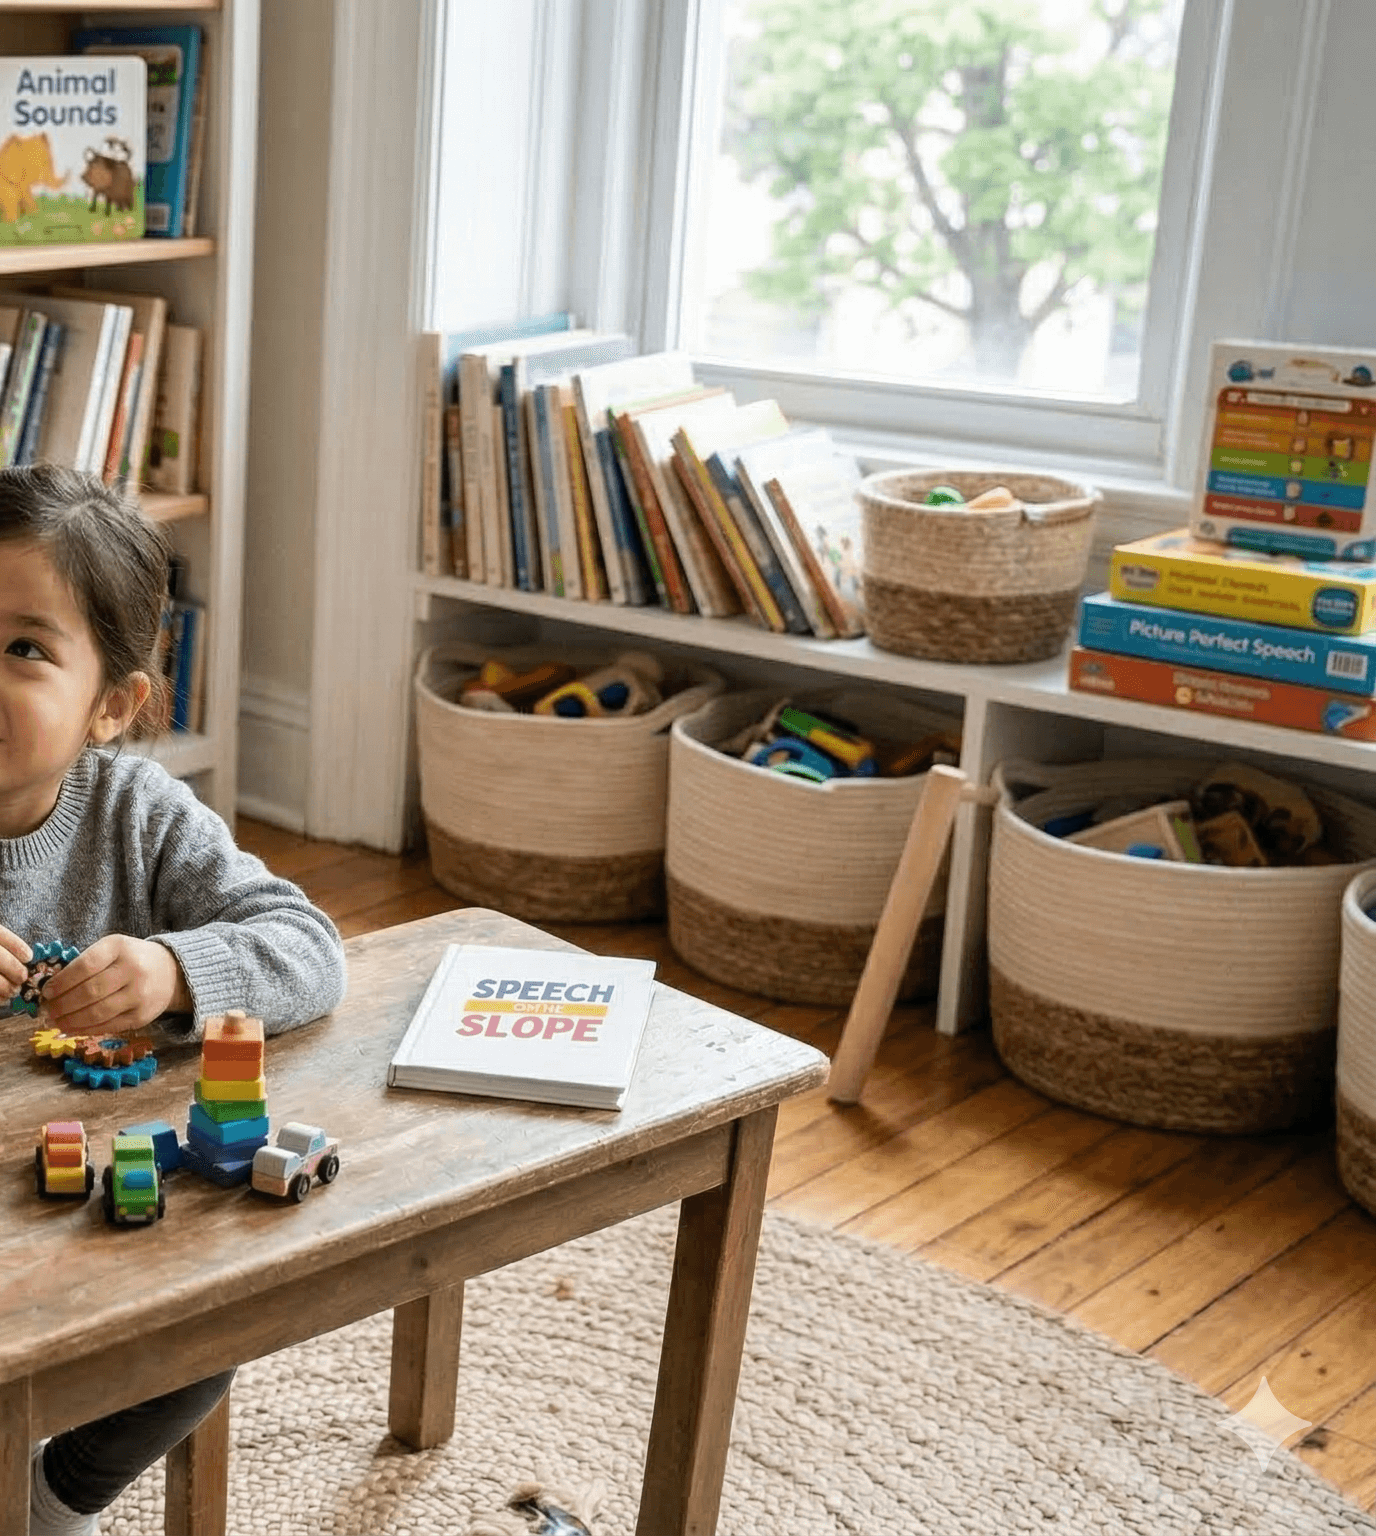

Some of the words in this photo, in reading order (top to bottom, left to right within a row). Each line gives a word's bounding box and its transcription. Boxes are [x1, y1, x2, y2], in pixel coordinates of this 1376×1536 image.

[16, 67, 116, 95] Animal
[14, 99, 117, 126] Sounds
[1129, 618, 1186, 643] Picture
[1189, 629, 1249, 653] Perfect
[1252, 638, 1316, 666] Speech
[472, 978, 615, 1004] SPEECH
[455, 1014, 604, 1042] SLOPE
